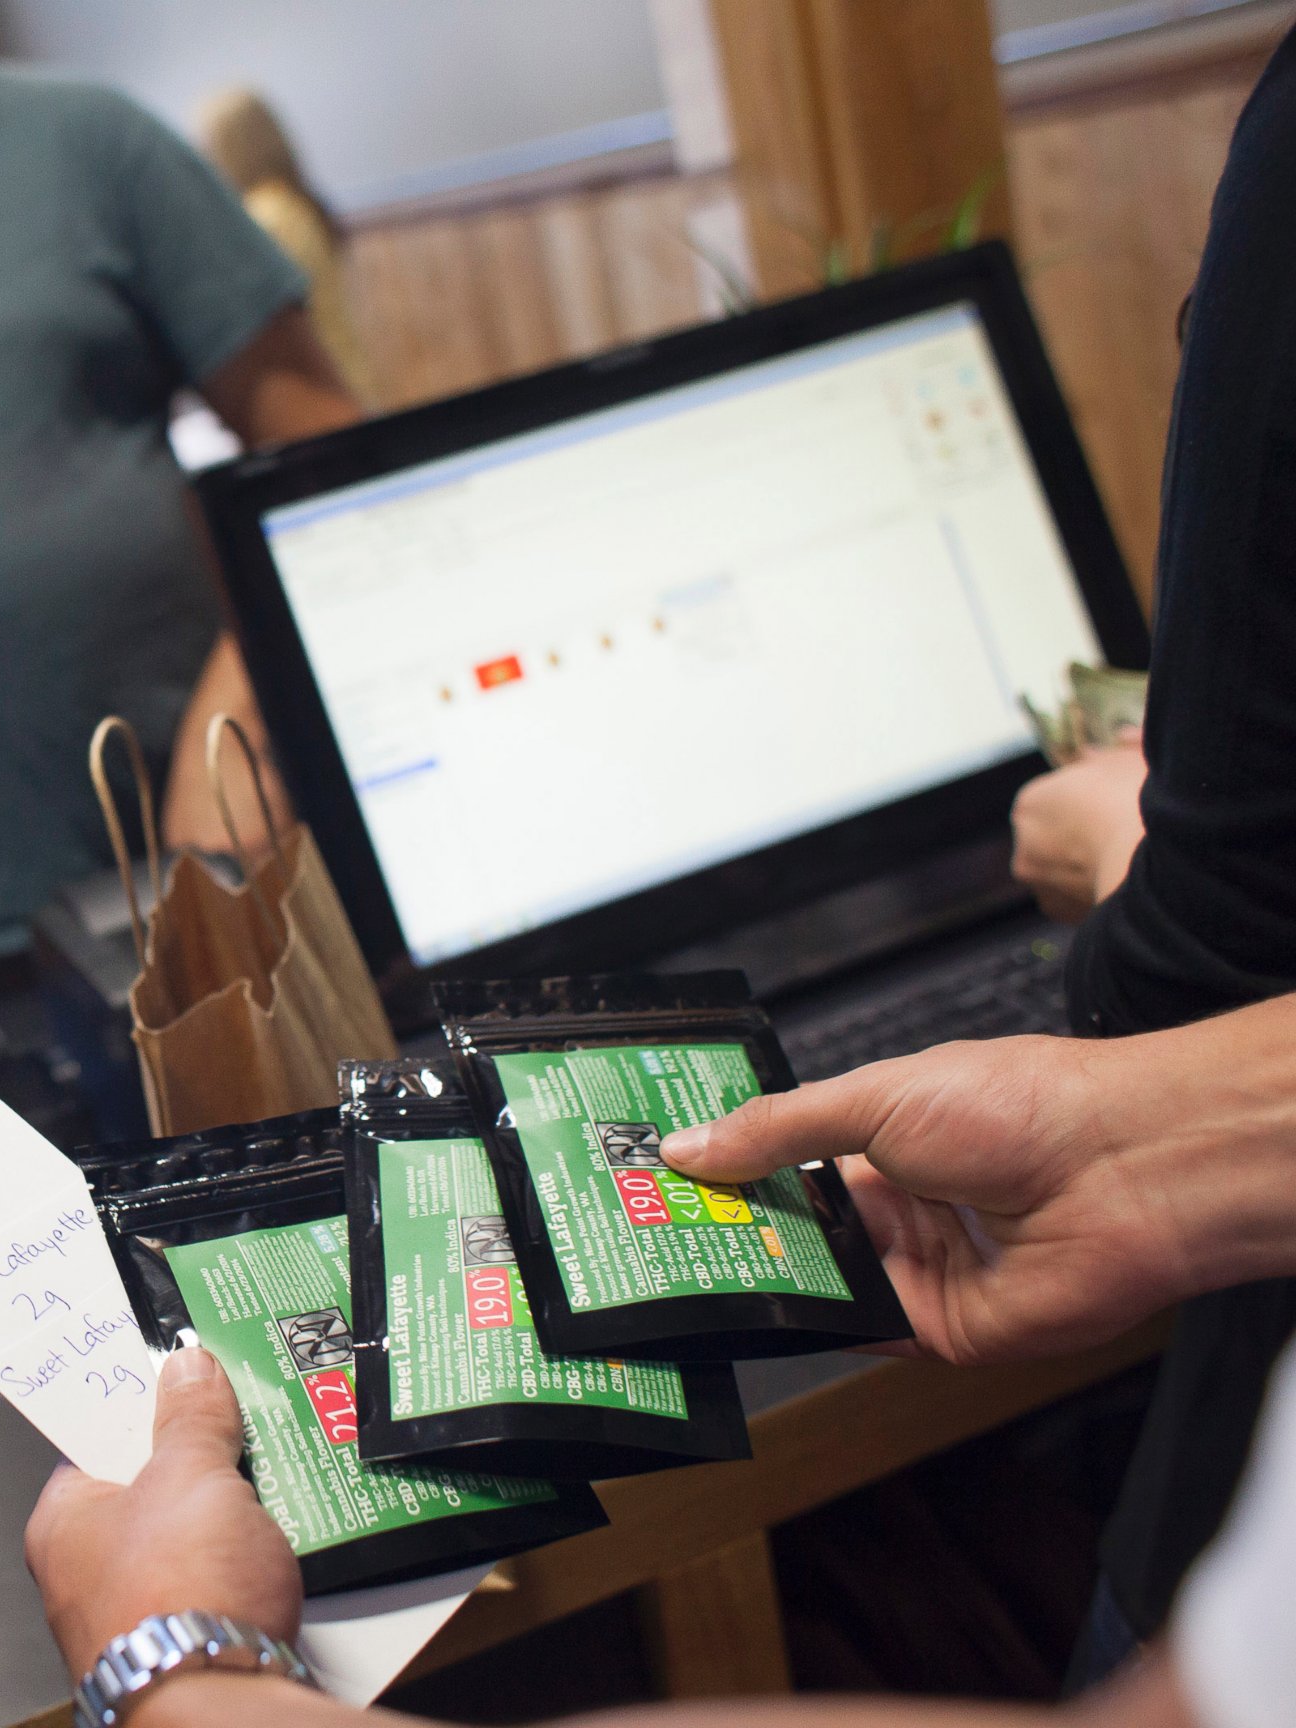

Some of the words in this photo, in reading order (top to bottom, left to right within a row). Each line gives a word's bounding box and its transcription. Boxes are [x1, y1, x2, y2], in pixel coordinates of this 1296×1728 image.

[655, 1078, 677, 1116] Content
[581, 1121, 598, 1150] Indica
[554, 1150, 572, 1187] Industries
[588, 1151, 606, 1171] 80%
[537, 1171, 574, 1252] Lafayette
[565, 1187, 581, 1216] Growth
[578, 1190, 590, 1207] WA
[444, 1218, 458, 1251] Indica
[575, 1216, 588, 1237] Point
[612, 1209, 631, 1245] Flower
[446, 1251, 459, 1273] 80%
[594, 1237, 608, 1262] Kitsap
[636, 1228, 670, 1293] THC-Total
[660, 1246, 680, 1282] THC-Acid
[678, 1228, 712, 1289] CBD-Total
[702, 1245, 723, 1280] CBD-Acid
[718, 1227, 755, 1287] CBG-Total
[744, 1244, 765, 1279] CBG-Acid
[560, 1253, 591, 1307] Sweet
[623, 1245, 648, 1296] Cannabis
[12, 1288, 72, 1321] 2g
[229, 1282, 251, 1318] Harvested
[245, 1291, 262, 1316] Tested
[389, 1274, 412, 1355] Lafayette
[263, 1320, 285, 1355] Indica
[452, 1313, 466, 1350] Flower
[0, 1350, 67, 1398] Sweet
[86, 1363, 146, 1399] 2g
[276, 1355, 295, 1380] 80%
[454, 1351, 470, 1404] Cannabis
[472, 1332, 492, 1400] THC-Total
[492, 1350, 505, 1388] THC-Acid
[516, 1332, 537, 1397] CBD-Total
[392, 1358, 413, 1414] Sweet
[308, 1425, 333, 1469] Flower
[252, 1456, 281, 1495] OG
[335, 1446, 378, 1526] THC-Total
[326, 1469, 357, 1531] Cannabis
